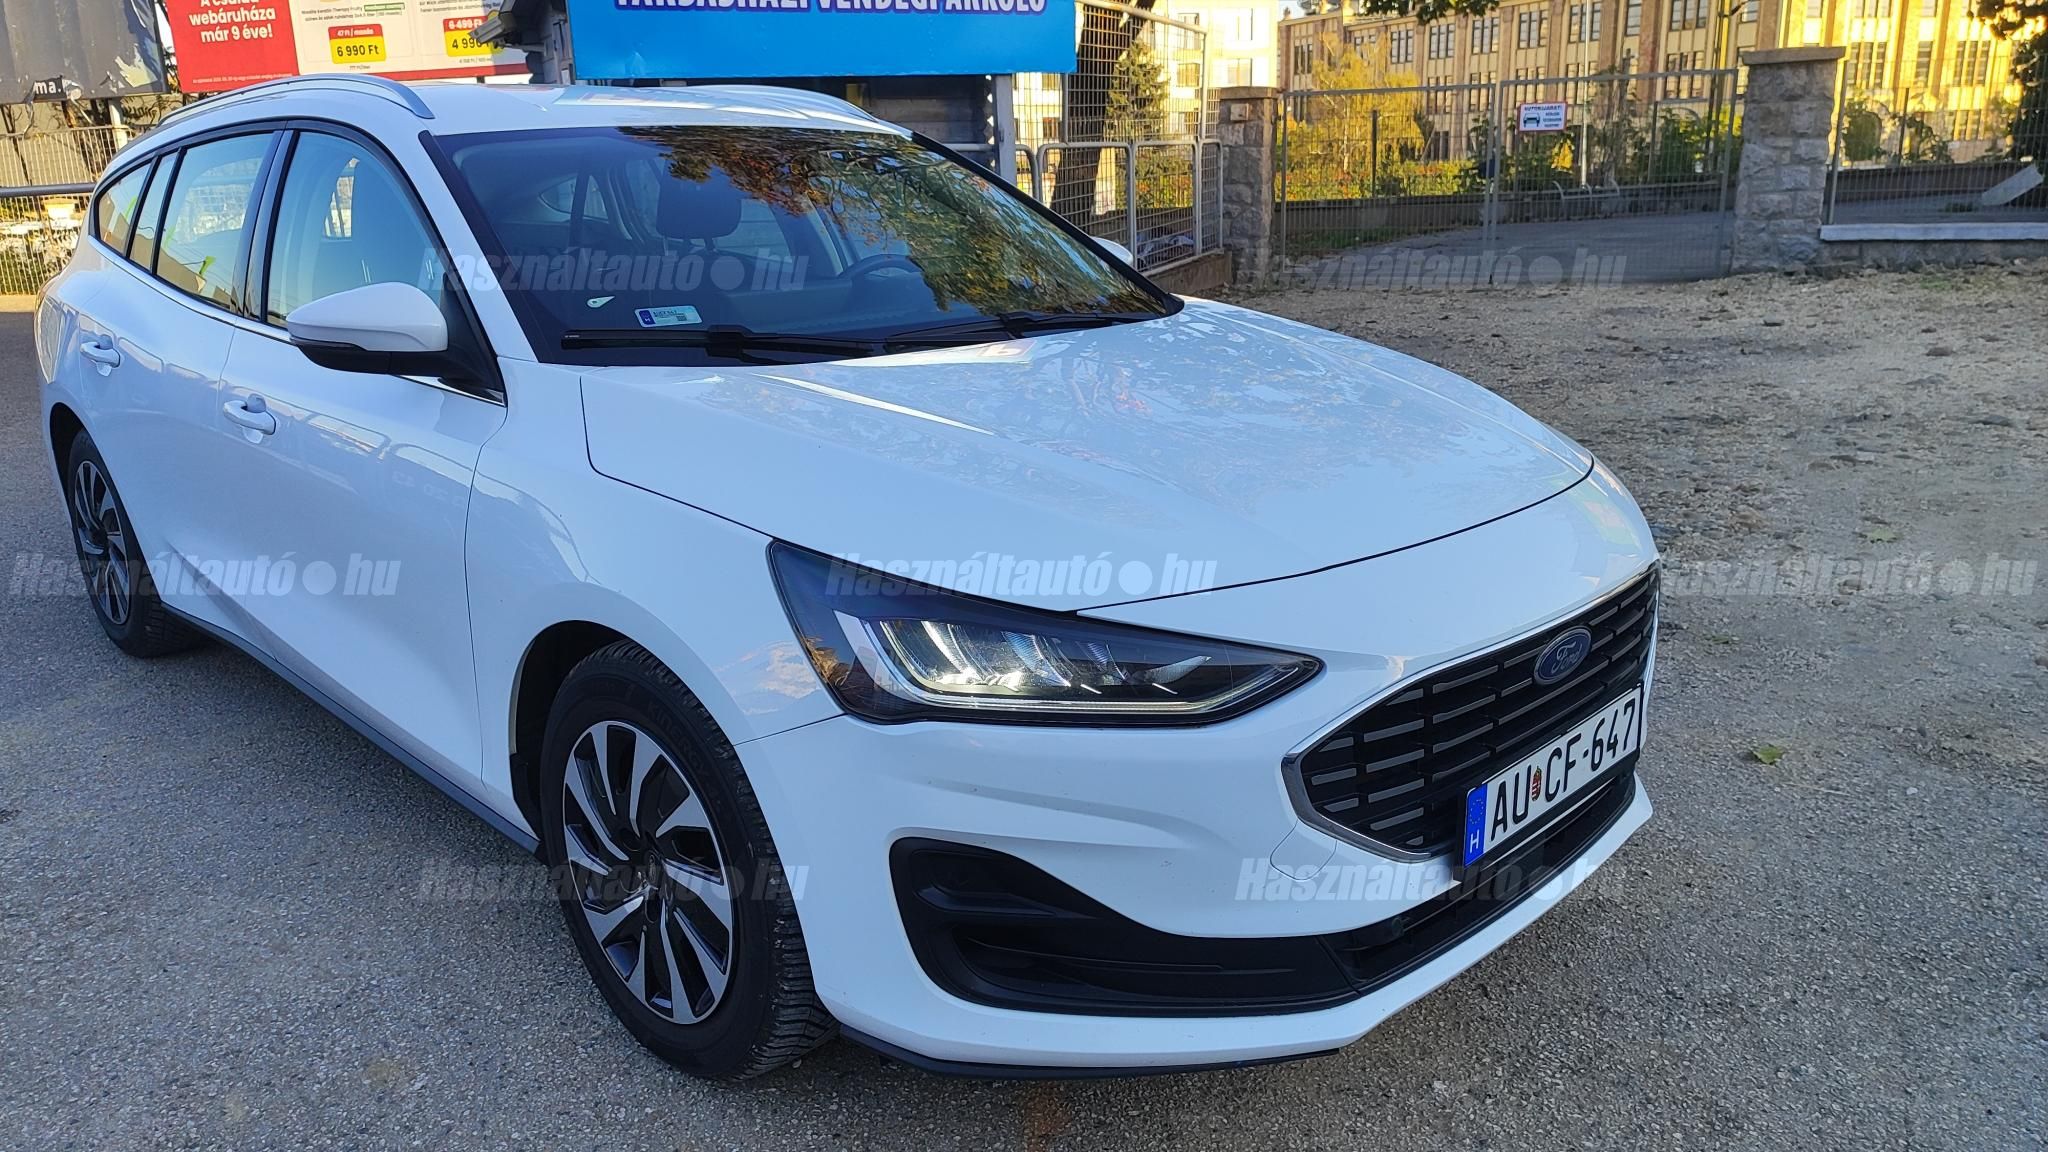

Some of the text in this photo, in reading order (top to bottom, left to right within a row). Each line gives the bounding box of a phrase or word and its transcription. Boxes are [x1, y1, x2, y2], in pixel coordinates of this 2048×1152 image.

[189, 6, 276, 26] webáruháza
[201, 24, 273, 43] már 9 éve!
[337, 45, 379, 57] 6 990 Ft
[452, 39, 459, 49] 4
[1550, 641, 1583, 675] Ford
[1490, 698, 1636, 841] AU CF-647
[1469, 829, 1480, 854] H
